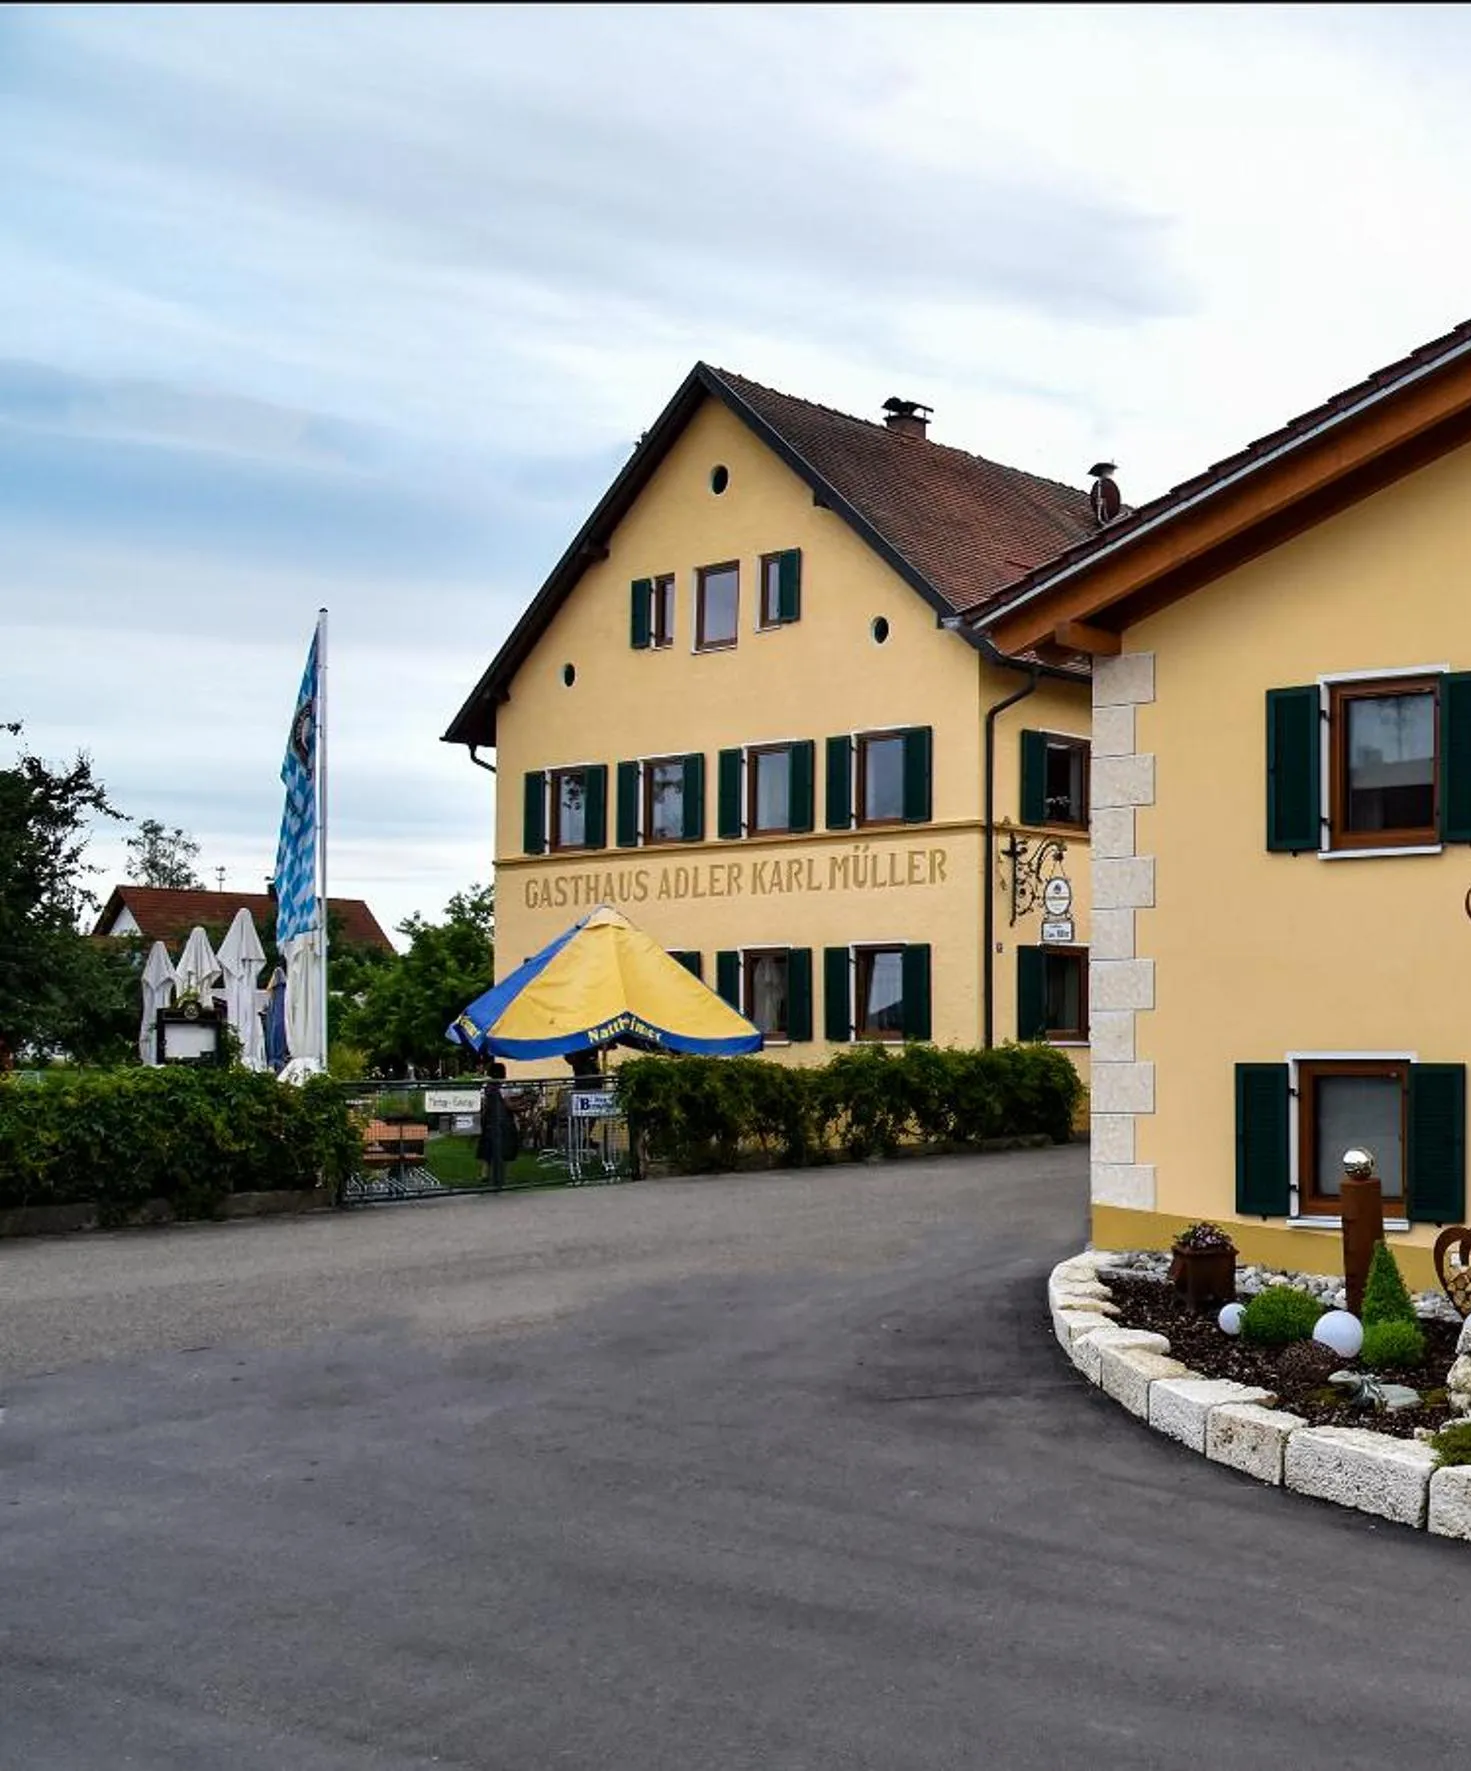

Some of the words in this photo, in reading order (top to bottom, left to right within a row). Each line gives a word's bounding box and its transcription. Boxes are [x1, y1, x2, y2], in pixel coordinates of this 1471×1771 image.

[524, 869, 650, 909] GASTHAUS
[657, 862, 742, 900] ADLER
[751, 858, 822, 895] KARL
[828, 845, 948, 890] MÜLLER
